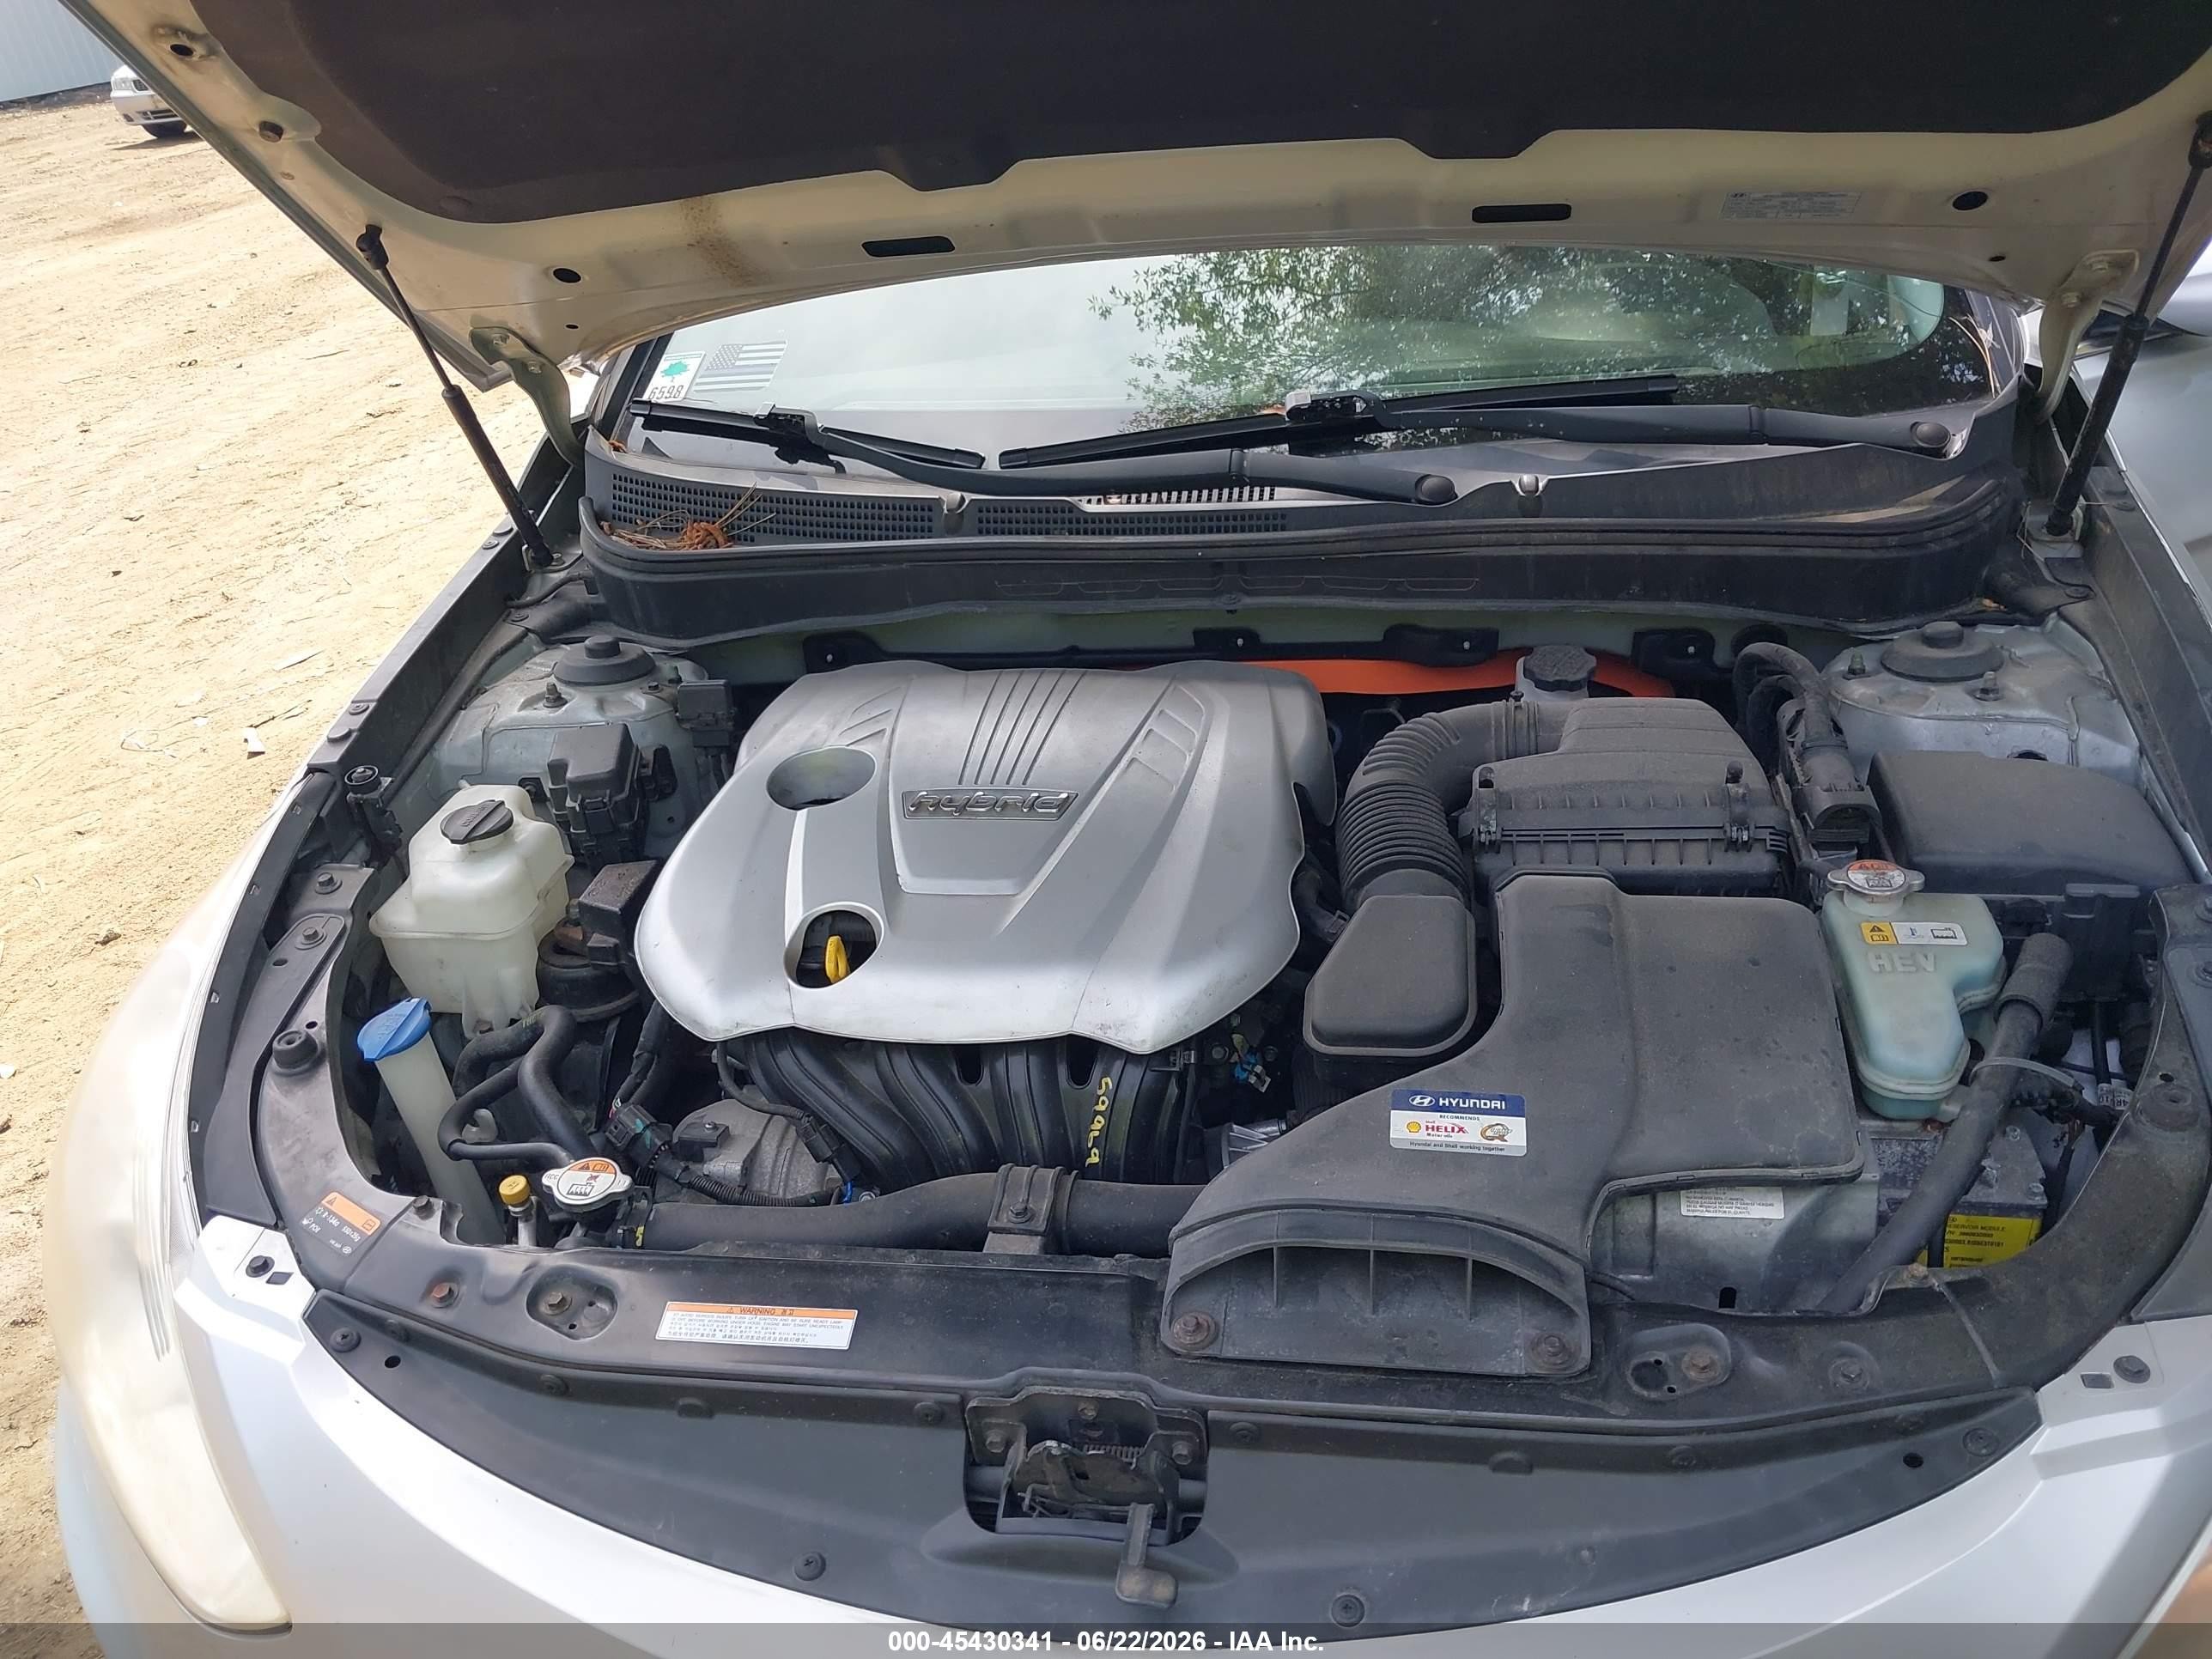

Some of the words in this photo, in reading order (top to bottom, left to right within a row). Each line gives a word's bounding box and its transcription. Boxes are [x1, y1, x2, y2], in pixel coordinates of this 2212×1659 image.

[647, 385, 684, 400] 6598
[908, 791, 1069, 816] hybrid
[1867, 951, 1937, 973] HEV
[1439, 1097, 1505, 1109] HYUNDAI
[1425, 1123, 1469, 1134] HELIX
[739, 1306, 775, 1316] WARNING
